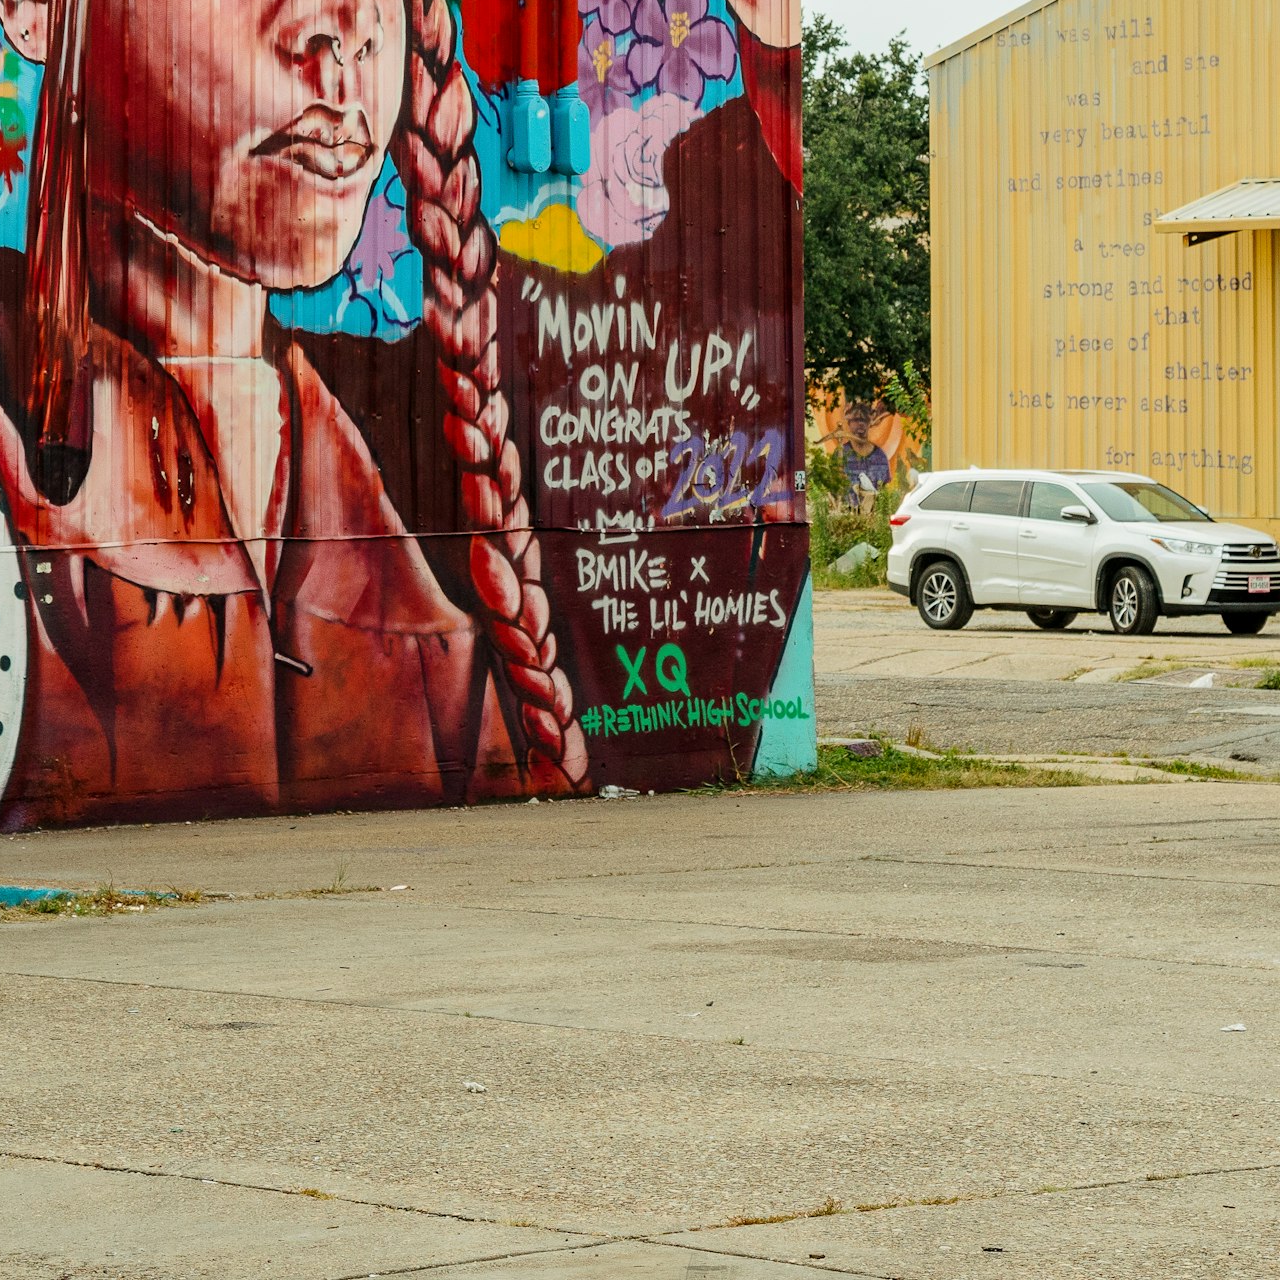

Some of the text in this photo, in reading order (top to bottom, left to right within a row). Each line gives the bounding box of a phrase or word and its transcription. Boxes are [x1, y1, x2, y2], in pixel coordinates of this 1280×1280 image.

[1056, 27, 1091, 44] was
[1132, 54, 1169, 76] and
[1066, 91, 1102, 108] was
[1040, 115, 1212, 148] very beautiful
[1007, 168, 1164, 193] and sometimes
[1074, 238, 1146, 259] a tree
[1043, 272, 1254, 302] strong and rooted
[1154, 306, 1201, 326] that
[1055, 332, 1150, 358] piece of
[579, 362, 639, 404] ON
[1164, 362, 1253, 382] shelter
[1009, 390, 1189, 414] that never asks
[539, 405, 692, 447] CONGRATS
[543, 449, 632, 497] CLASS
[635, 450, 670, 483] OF
[1106, 447, 1253, 475] for anything
[576, 548, 669, 593] BMIKE
[591, 594, 640, 635] THE
[693, 588, 788, 629] HOMIES
[616, 641, 692, 701] XQ
